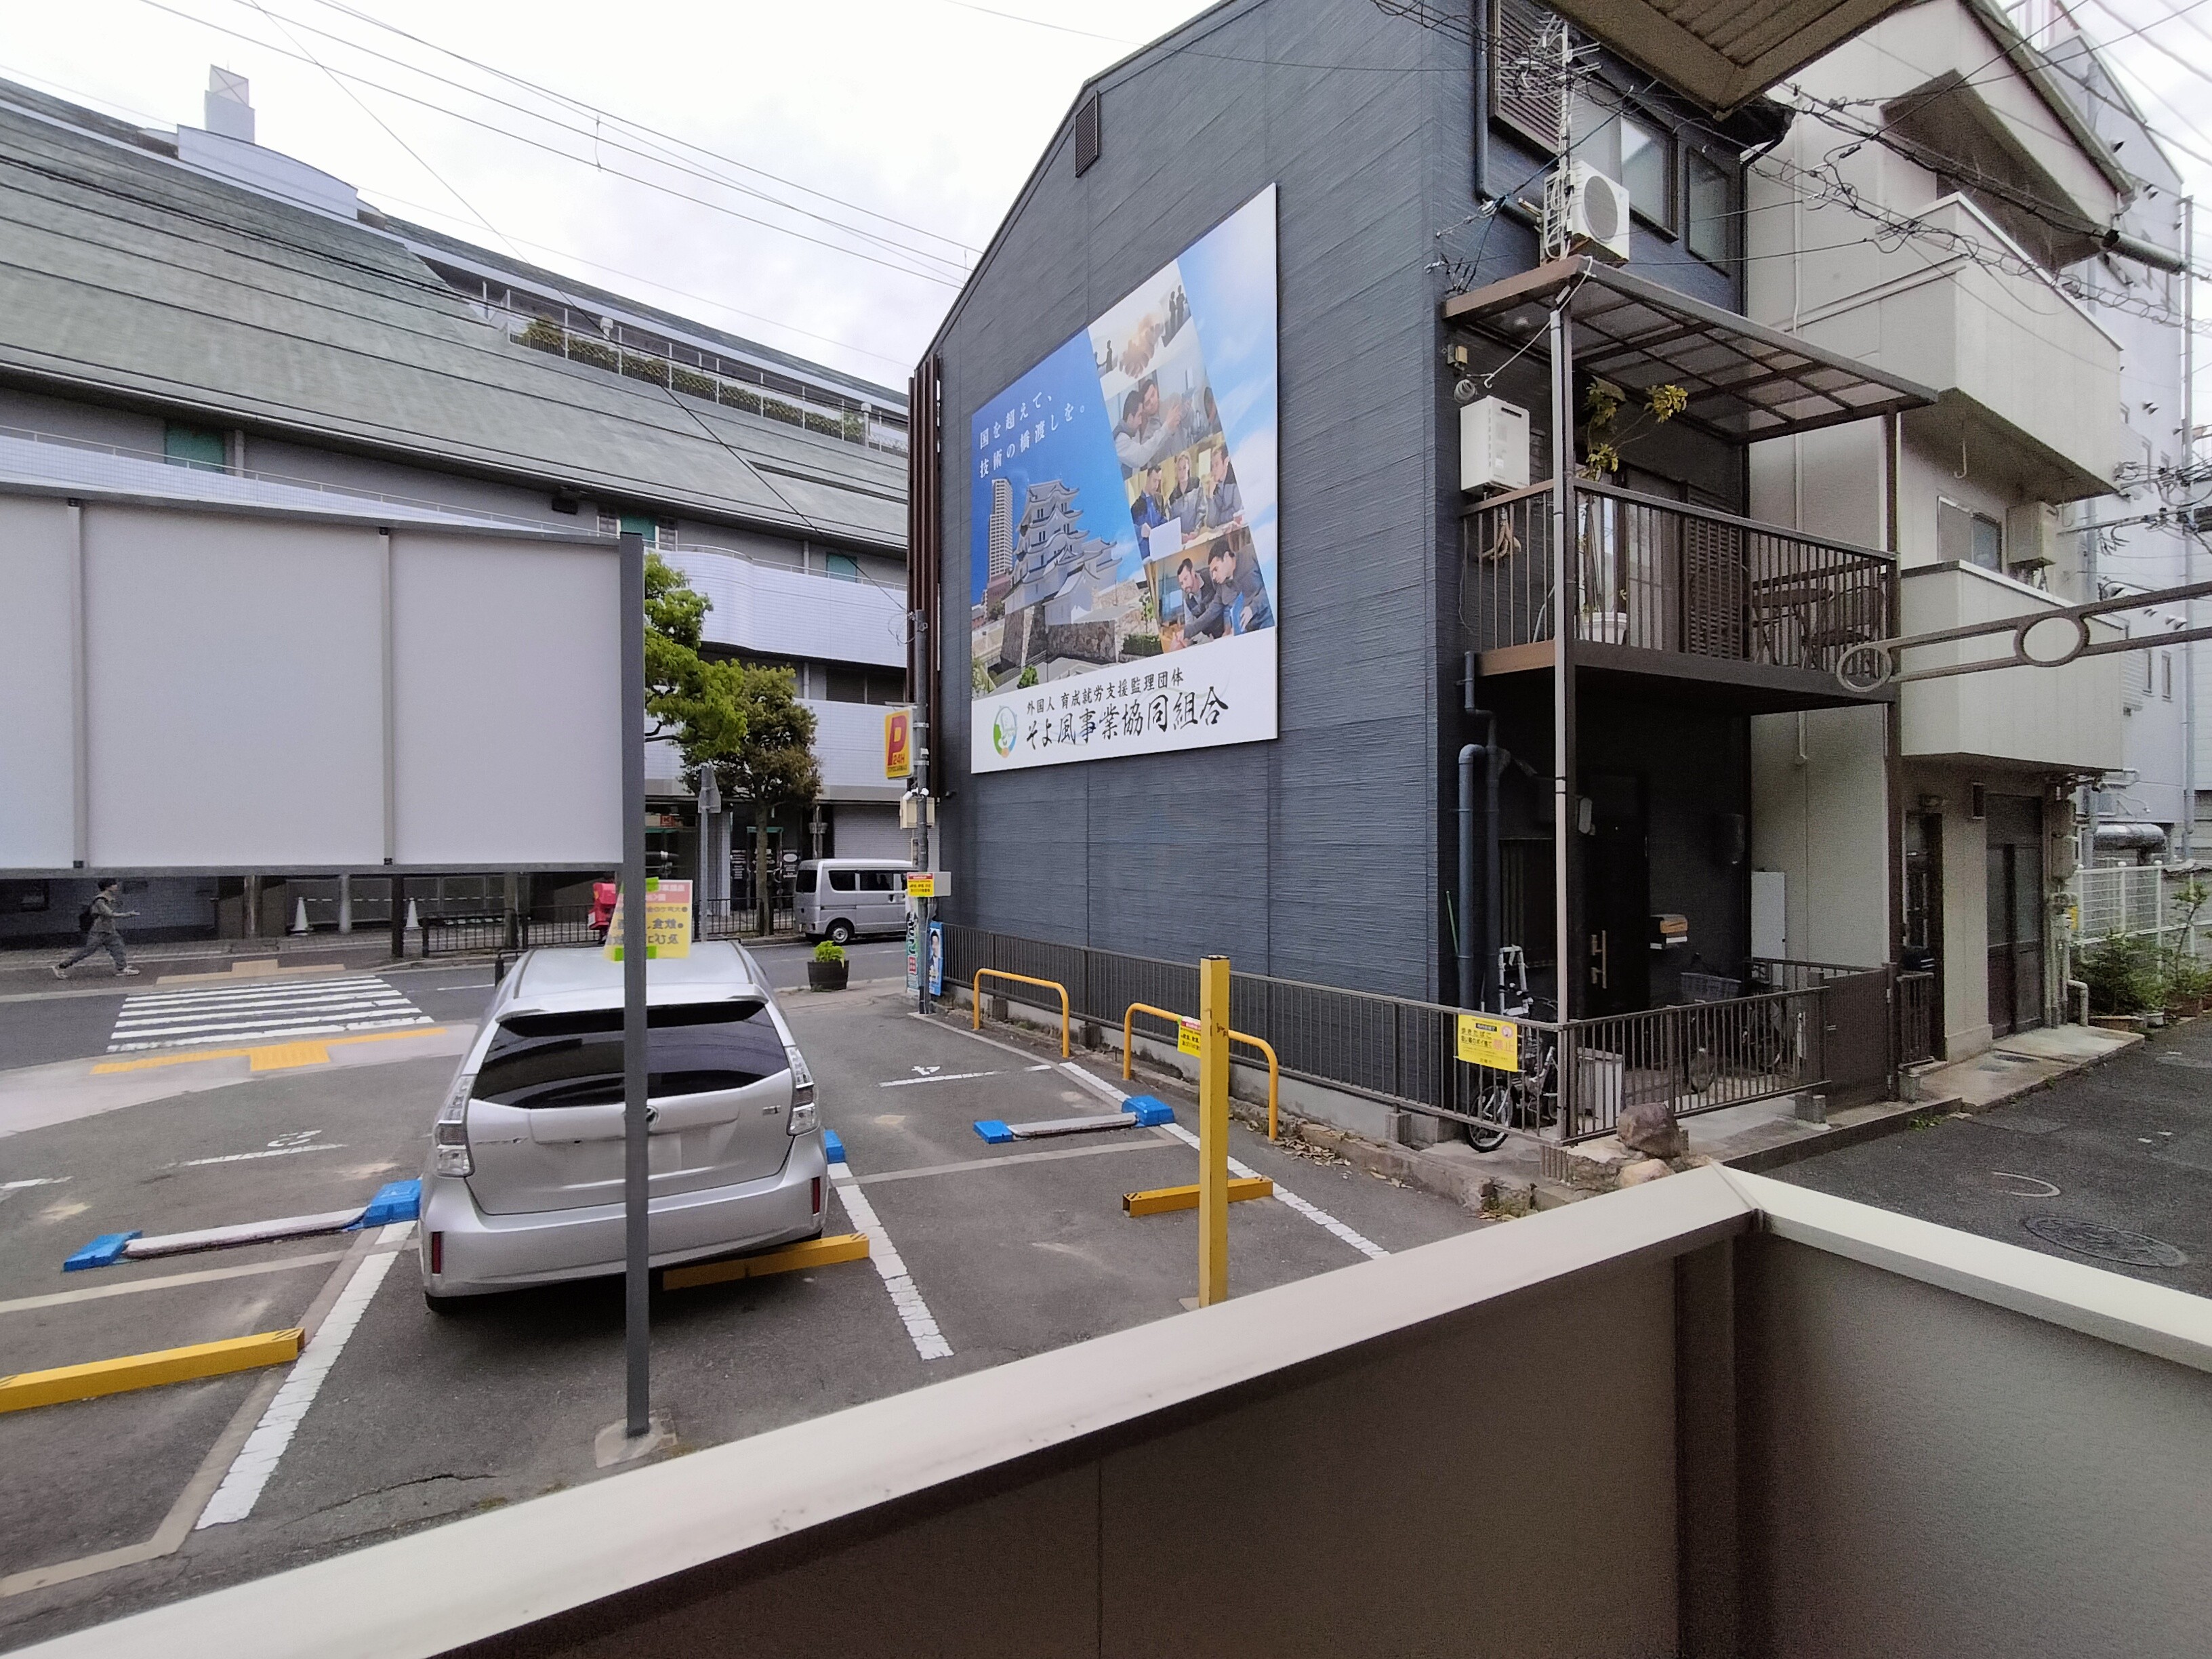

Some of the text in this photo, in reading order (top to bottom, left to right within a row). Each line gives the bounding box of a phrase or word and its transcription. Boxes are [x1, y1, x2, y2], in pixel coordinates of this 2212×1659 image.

[980, 392, 1052, 449] 国を超えて、
[980, 403, 1084, 478] 技術の橋渡しを。
[1026, 686, 1229, 750] そよ風事業協同組合
[1027, 668, 1184, 715] 外国人 育成就労支援監理団体
[888, 715, 907, 766] P
[893, 753, 905, 765] 24H
